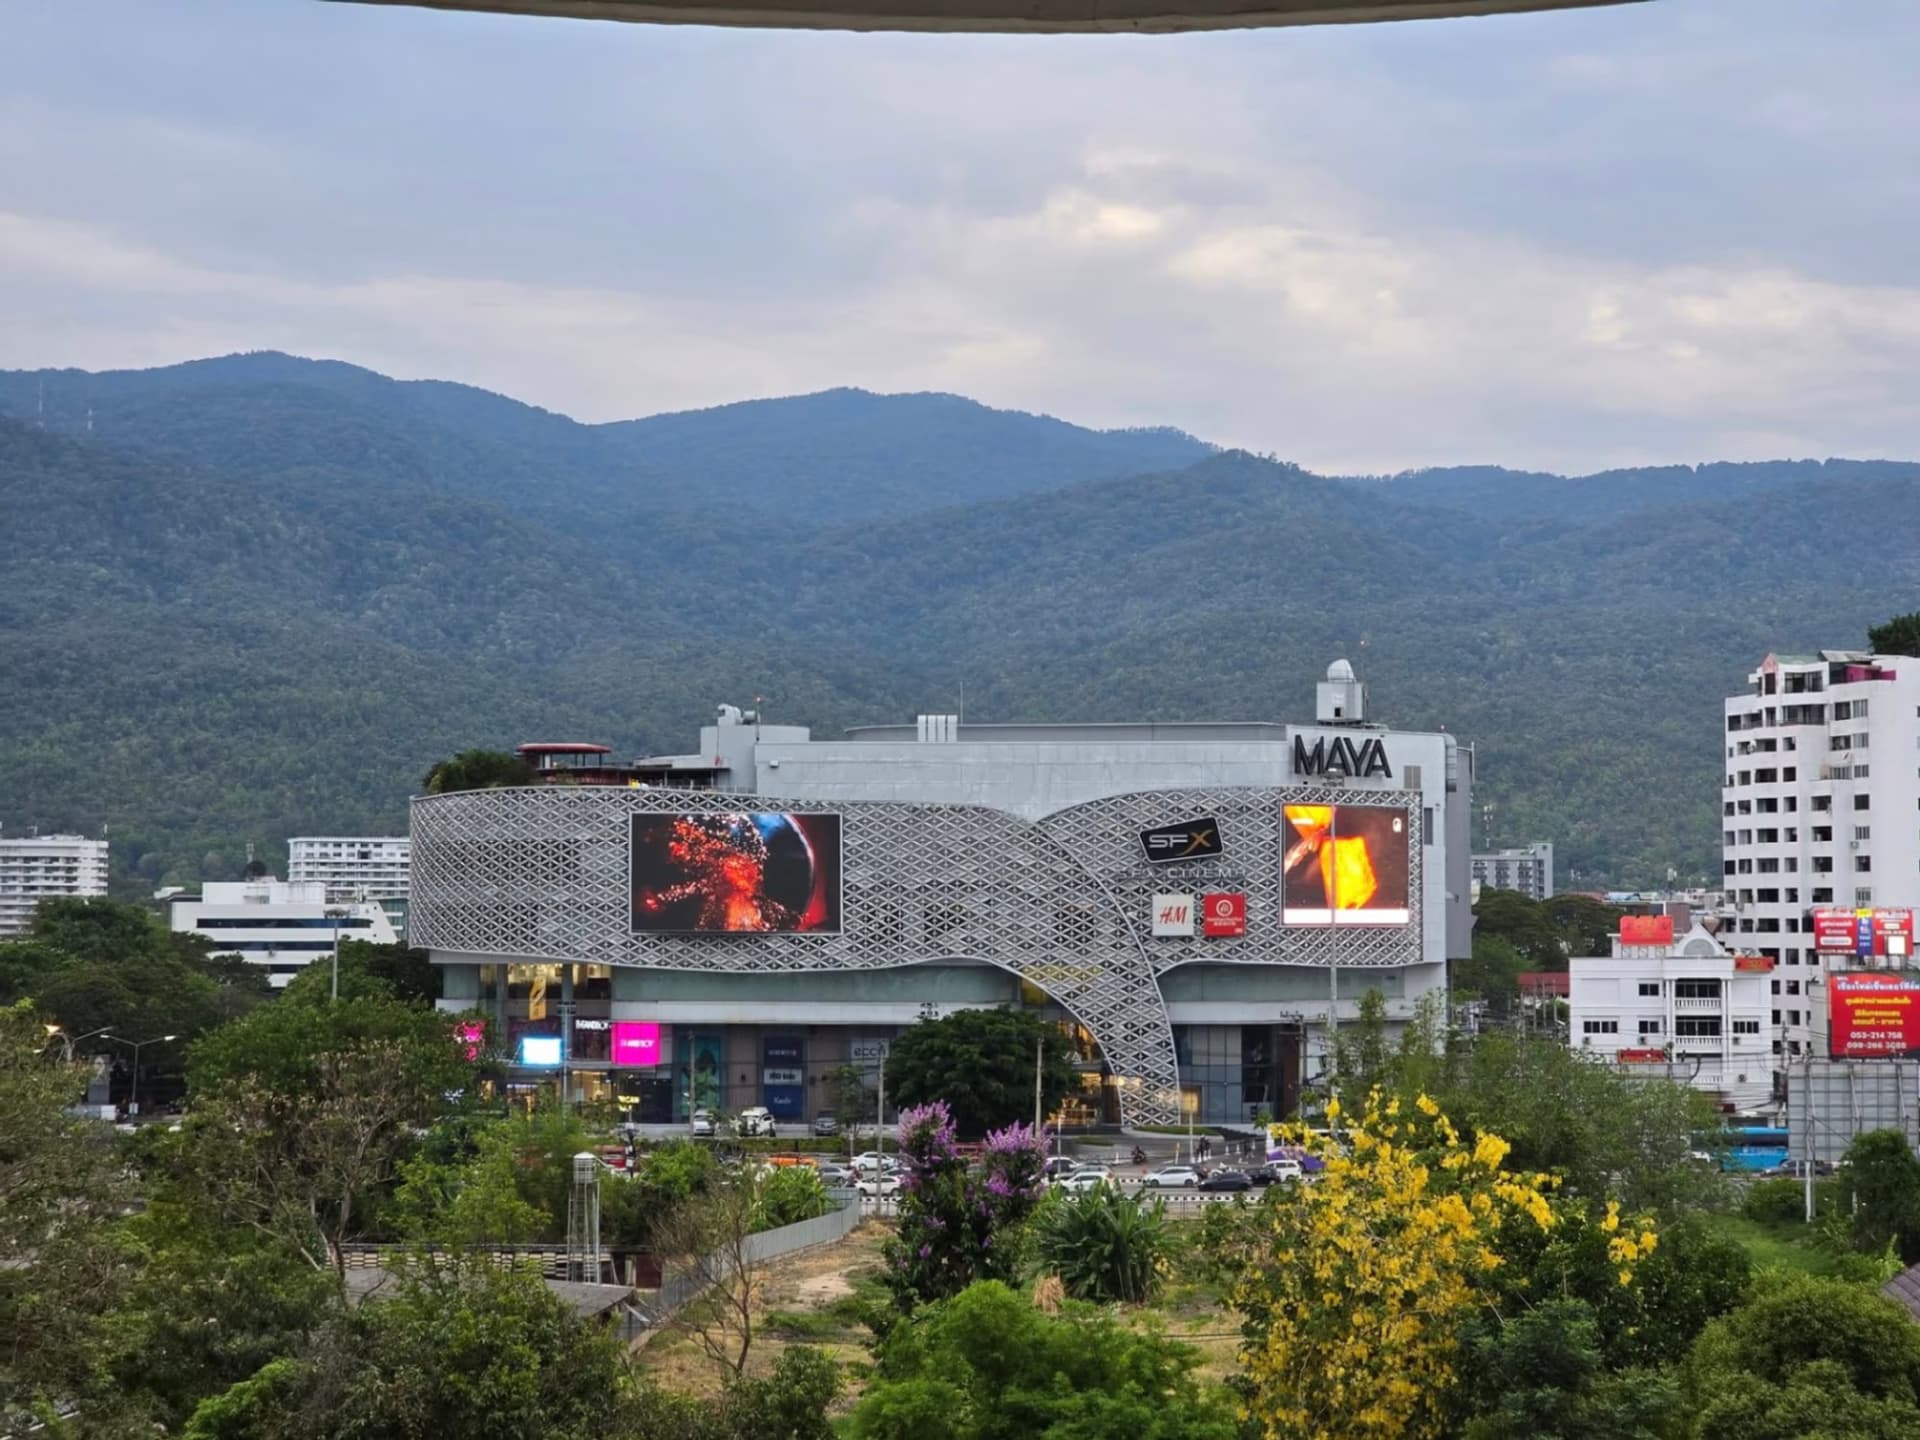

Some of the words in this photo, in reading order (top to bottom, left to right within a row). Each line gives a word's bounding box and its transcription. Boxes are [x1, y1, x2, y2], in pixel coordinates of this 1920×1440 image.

[1294, 734, 1392, 778] MAYA
[1148, 829, 1214, 856] SFX
[1159, 906, 1188, 926] H&M
